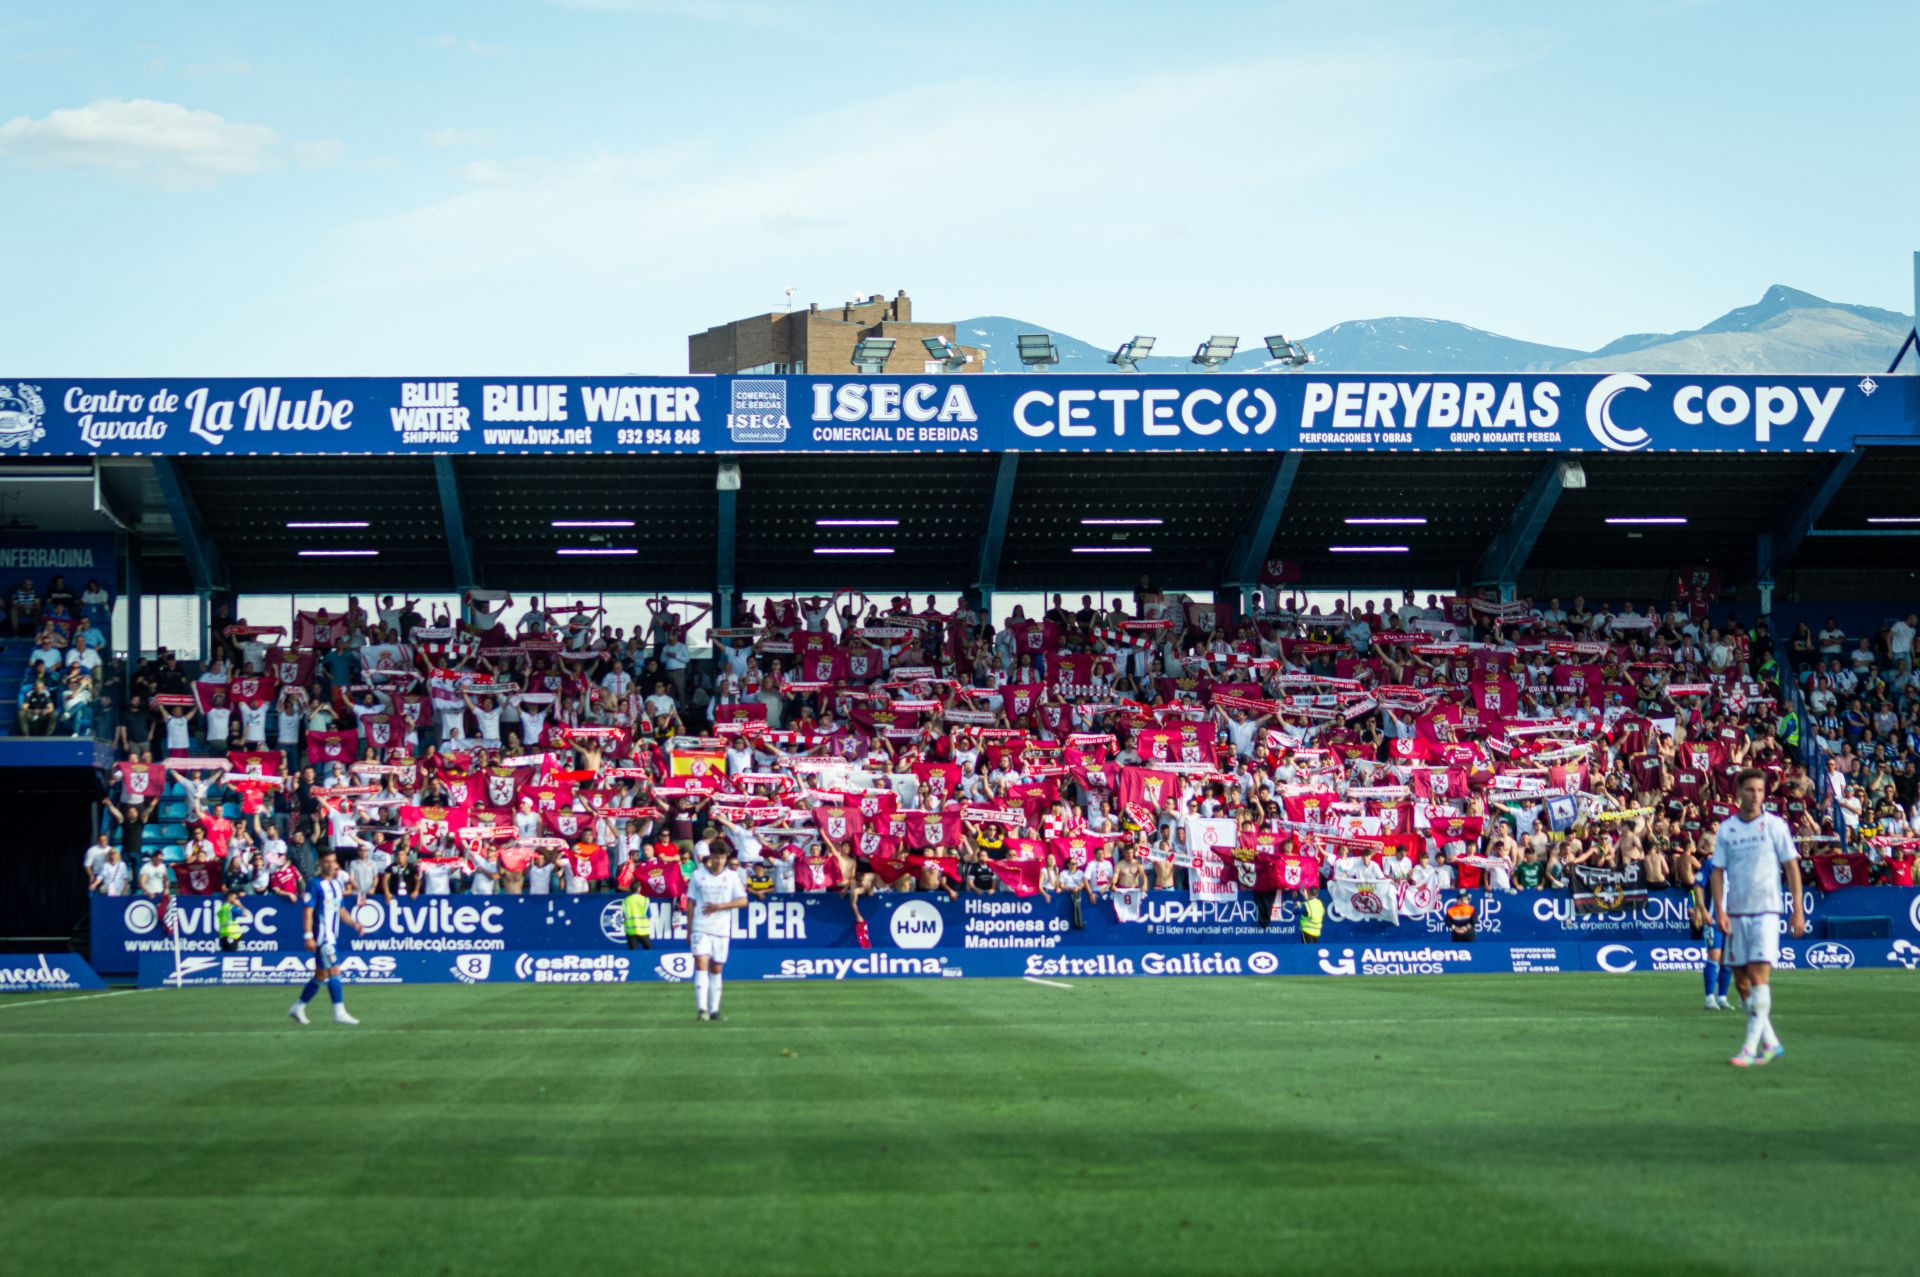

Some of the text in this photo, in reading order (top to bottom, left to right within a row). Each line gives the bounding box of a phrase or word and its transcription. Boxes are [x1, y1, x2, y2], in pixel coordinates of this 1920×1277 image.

[64, 386, 180, 413] Centro de
[401, 383, 459, 407] BLUE
[736, 392, 781, 400] COMERCIAL
[811, 383, 978, 422] ISECA
[483, 385, 701, 422] BLUE WATER
[736, 401, 782, 409] DE BEBIDAS
[1300, 381, 1561, 428] PERYBRAS
[184, 386, 354, 445] La Nube
[390, 407, 470, 431] WATER
[1012, 387, 1277, 437] CETECO
[1673, 385, 1846, 442] copy
[726, 414, 791, 429] ISECA
[78, 415, 168, 447] Lavado
[402, 431, 459, 444] SHIPPING
[483, 426, 700, 445] www.bws.net 932 954 848
[813, 427, 978, 441] COMERCIAL DE BEBIDAS
[1300, 432, 1412, 443] PERFORACIONES Y OBRAS
[1450, 432, 1561, 443] GRUPO MORANTE PEREDA
[1191, 881, 1235, 895] CULTURAL
[965, 900, 1033, 915] Hispano
[389, 898, 504, 934] tvitec
[896, 920, 937, 934] HJM
[965, 917, 1070, 933] Japonesa de
[1157, 926, 1165, 935] El
[1186, 926, 1220, 935] mundial
[1266, 926, 1295, 935] natural
[350, 937, 505, 952] www.tvitecglass.com
[535, 955, 630, 970] esRadio
[1361, 947, 1472, 962] Almudena
[1810, 950, 1850, 964] ibsa
[468, 957, 483, 974] 8
[672, 956, 686, 973] 8
[781, 953, 942, 980] sanyclima
[1024, 952, 1241, 975] Estrella Galicia
[535, 970, 629, 982] Bierzo 98.7
